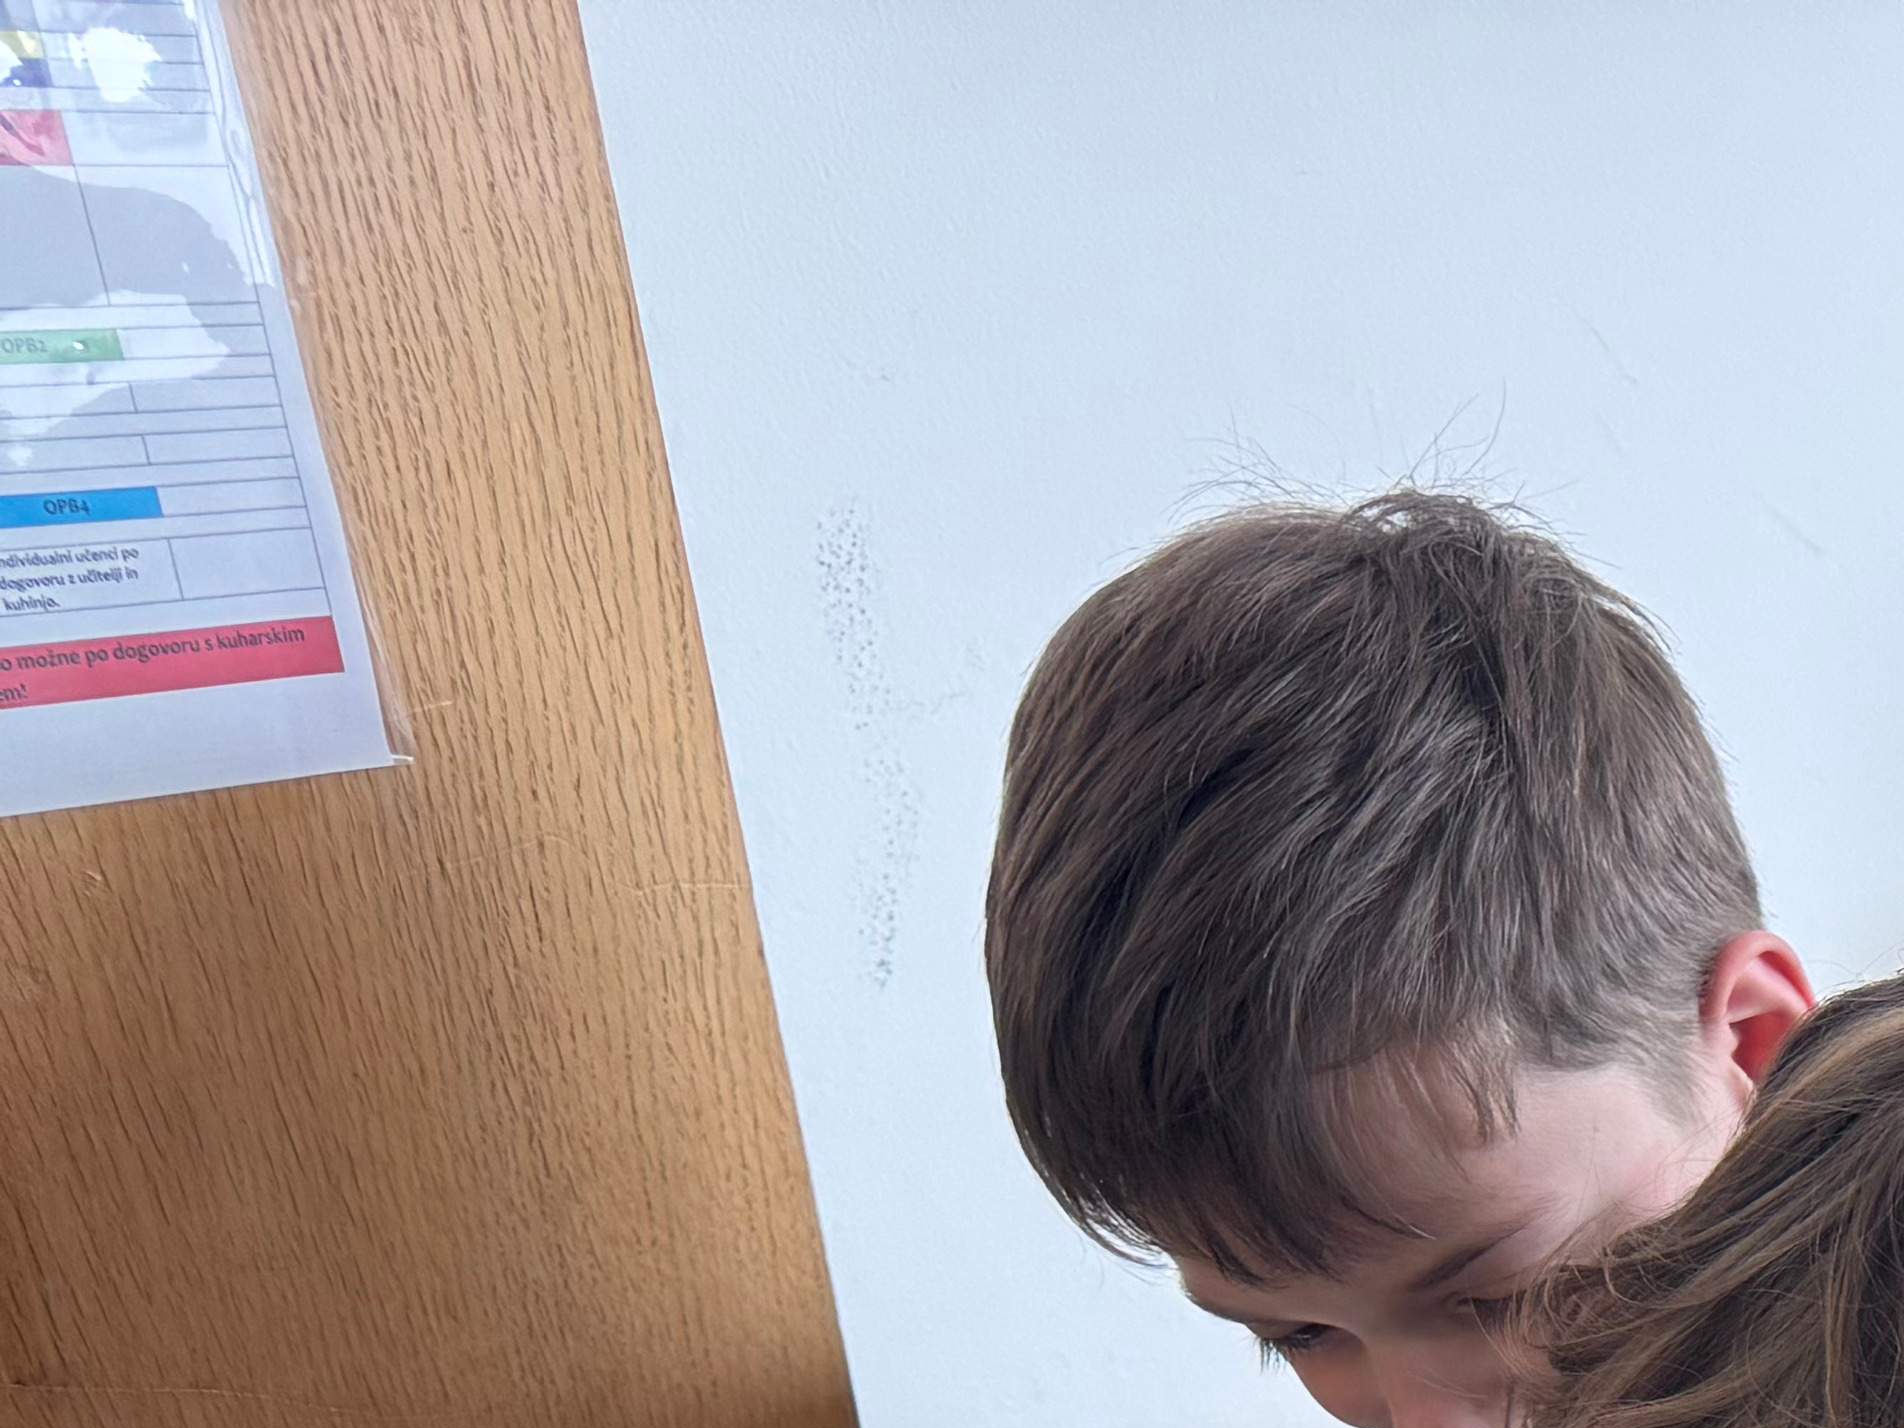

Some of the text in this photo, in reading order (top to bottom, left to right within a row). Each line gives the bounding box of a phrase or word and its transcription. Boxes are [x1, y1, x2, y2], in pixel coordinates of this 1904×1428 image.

[43, 498, 91, 516] OPB4
[0, 549, 73, 568] ndividualni
[16, 649, 81, 669] možne
[85, 648, 109, 669] po
[113, 640, 201, 663] dogovoru
[216, 627, 305, 650] kuharskim
